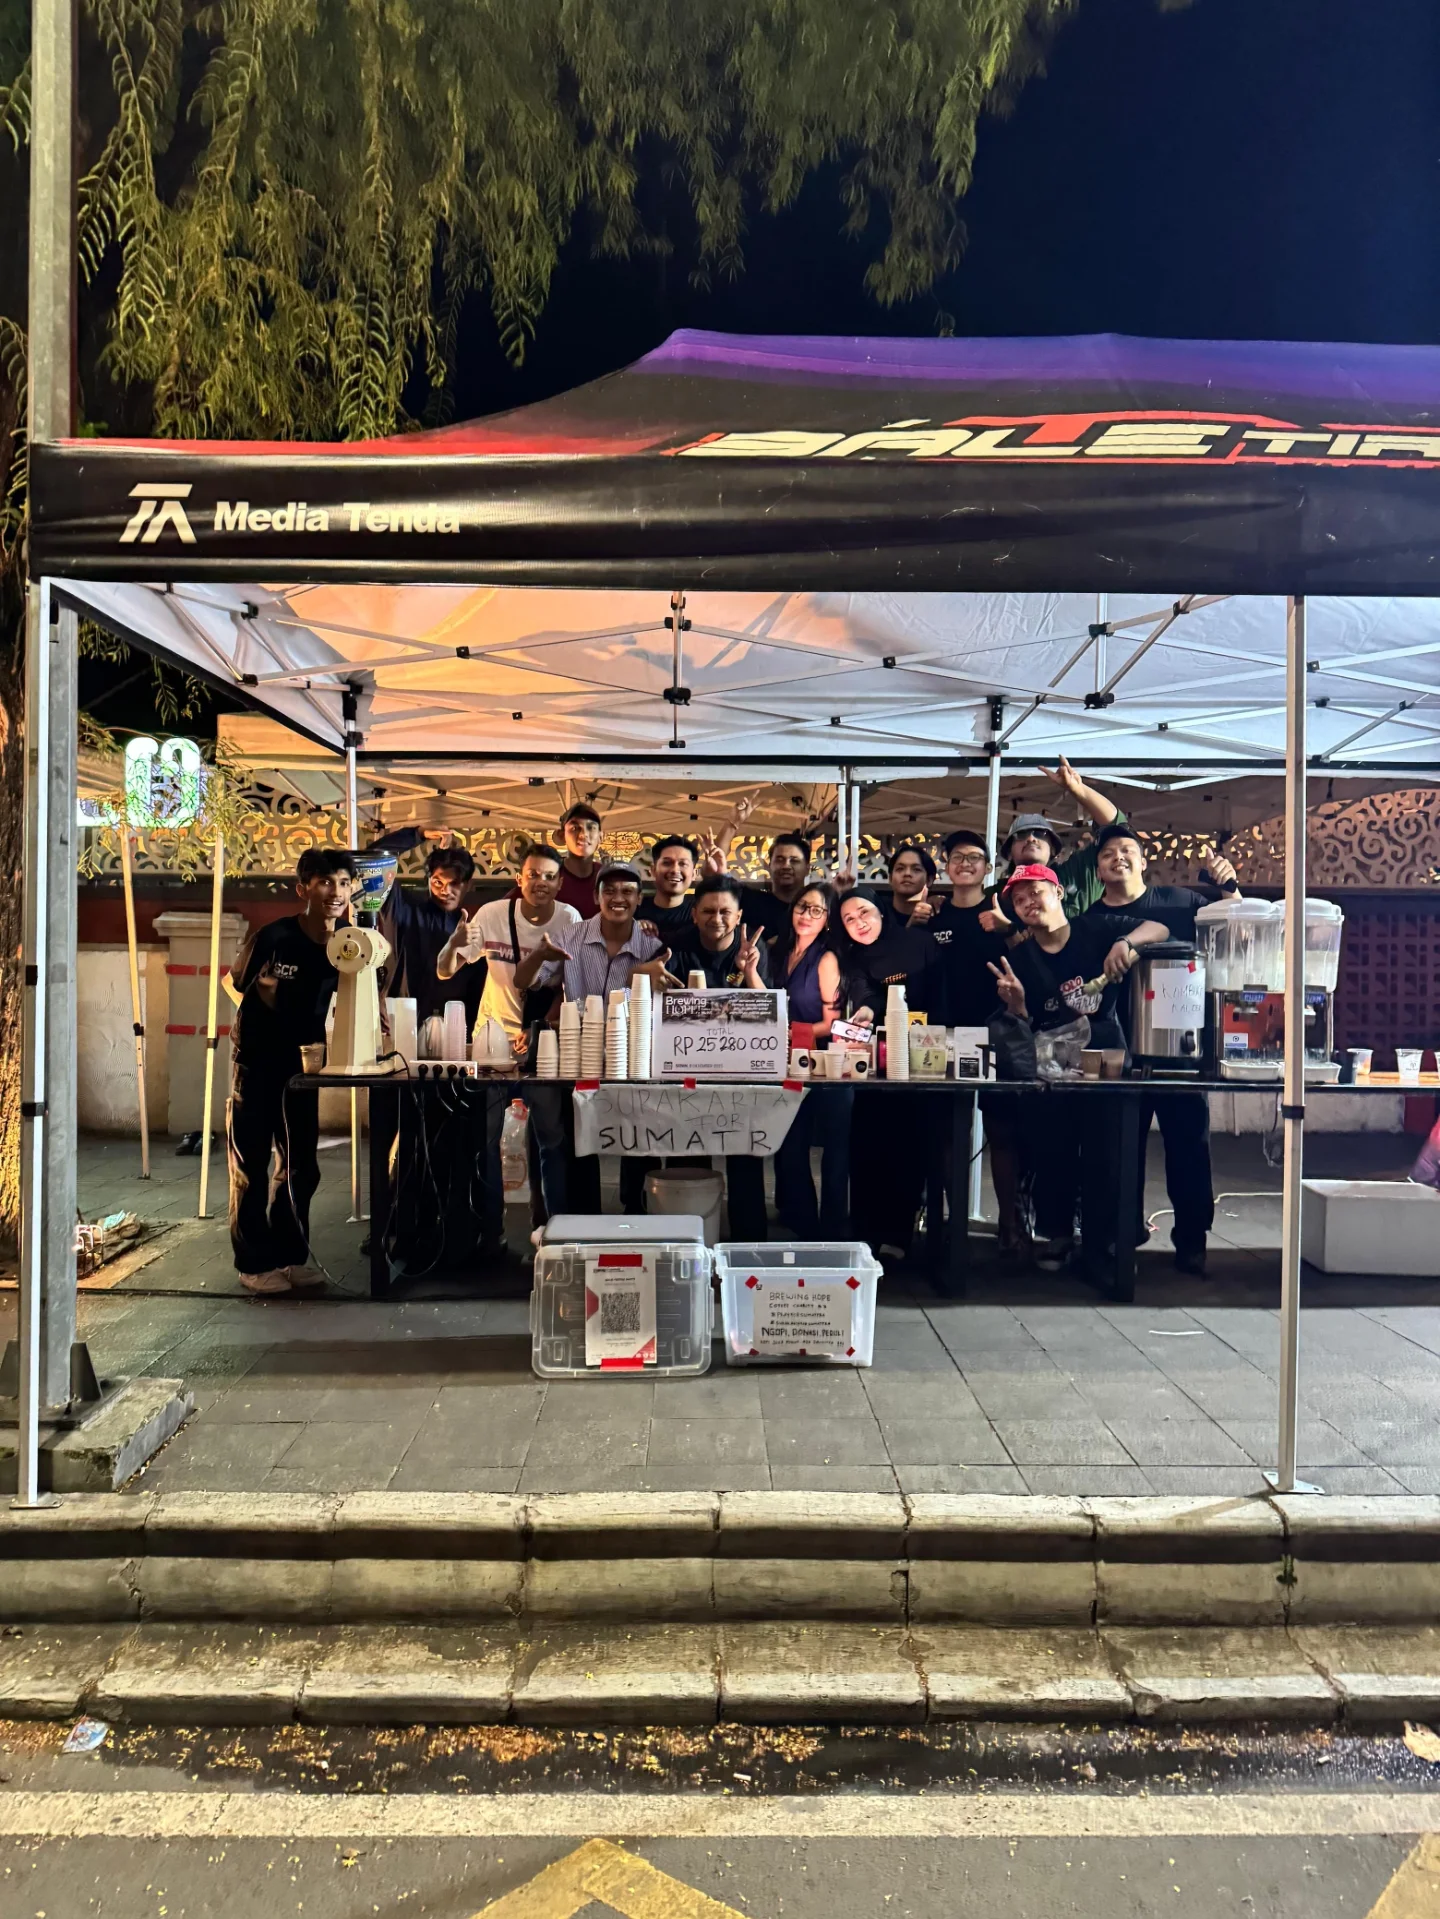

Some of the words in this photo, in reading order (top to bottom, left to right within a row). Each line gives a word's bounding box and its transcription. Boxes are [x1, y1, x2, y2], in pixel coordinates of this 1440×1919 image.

[213, 500, 329, 533] Media
[343, 501, 461, 534] Tenda
[665, 996, 707, 1008] Brewing
[706, 1028, 734, 1036] TOTAL
[673, 1035, 694, 1056] RP
[696, 1036, 717, 1052] 25
[750, 1036, 778, 1051] 000
[592, 1089, 789, 1116] SURAKARTA
[686, 1113, 744, 1129] FOR
[769, 1292, 809, 1301] BREWING
[812, 1293, 831, 1302] HOPE
